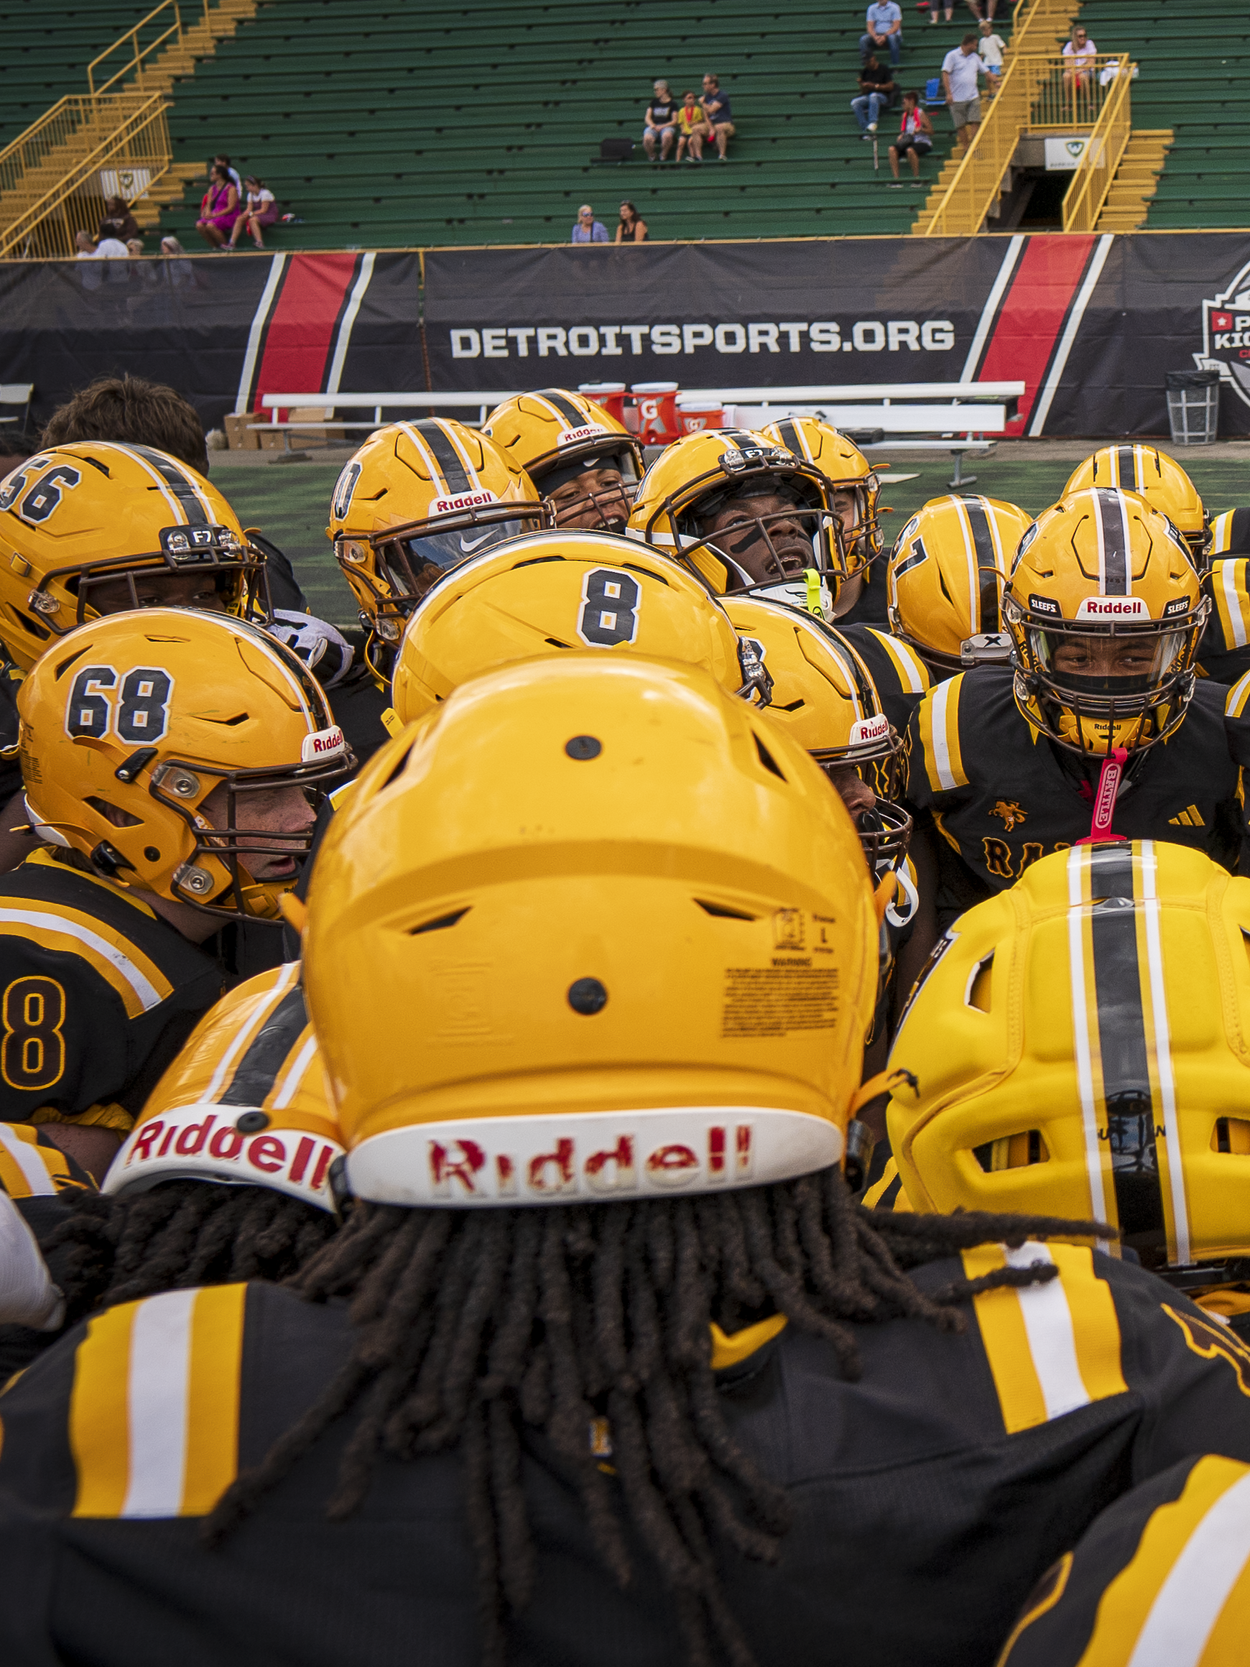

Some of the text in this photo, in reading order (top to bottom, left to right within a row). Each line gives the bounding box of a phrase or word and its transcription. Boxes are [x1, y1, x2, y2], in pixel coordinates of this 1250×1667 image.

[450, 320, 955, 358] DETROITSPORTS.ORG
[641, 400, 658, 419] G
[437, 492, 493, 513] Riddell
[192, 530, 212, 544] F7
[576, 566, 642, 649] 8
[1031, 599, 1057, 613] SLEEFS
[1087, 601, 1141, 614] Riddell
[1167, 600, 1188, 614] SLEEFS
[65, 665, 175, 745] 68
[1098, 769, 1118, 823] BATTLE
[1, 975, 66, 1091] 8
[128, 1113, 333, 1191] Riddell
[428, 1123, 757, 1198] Riddell
